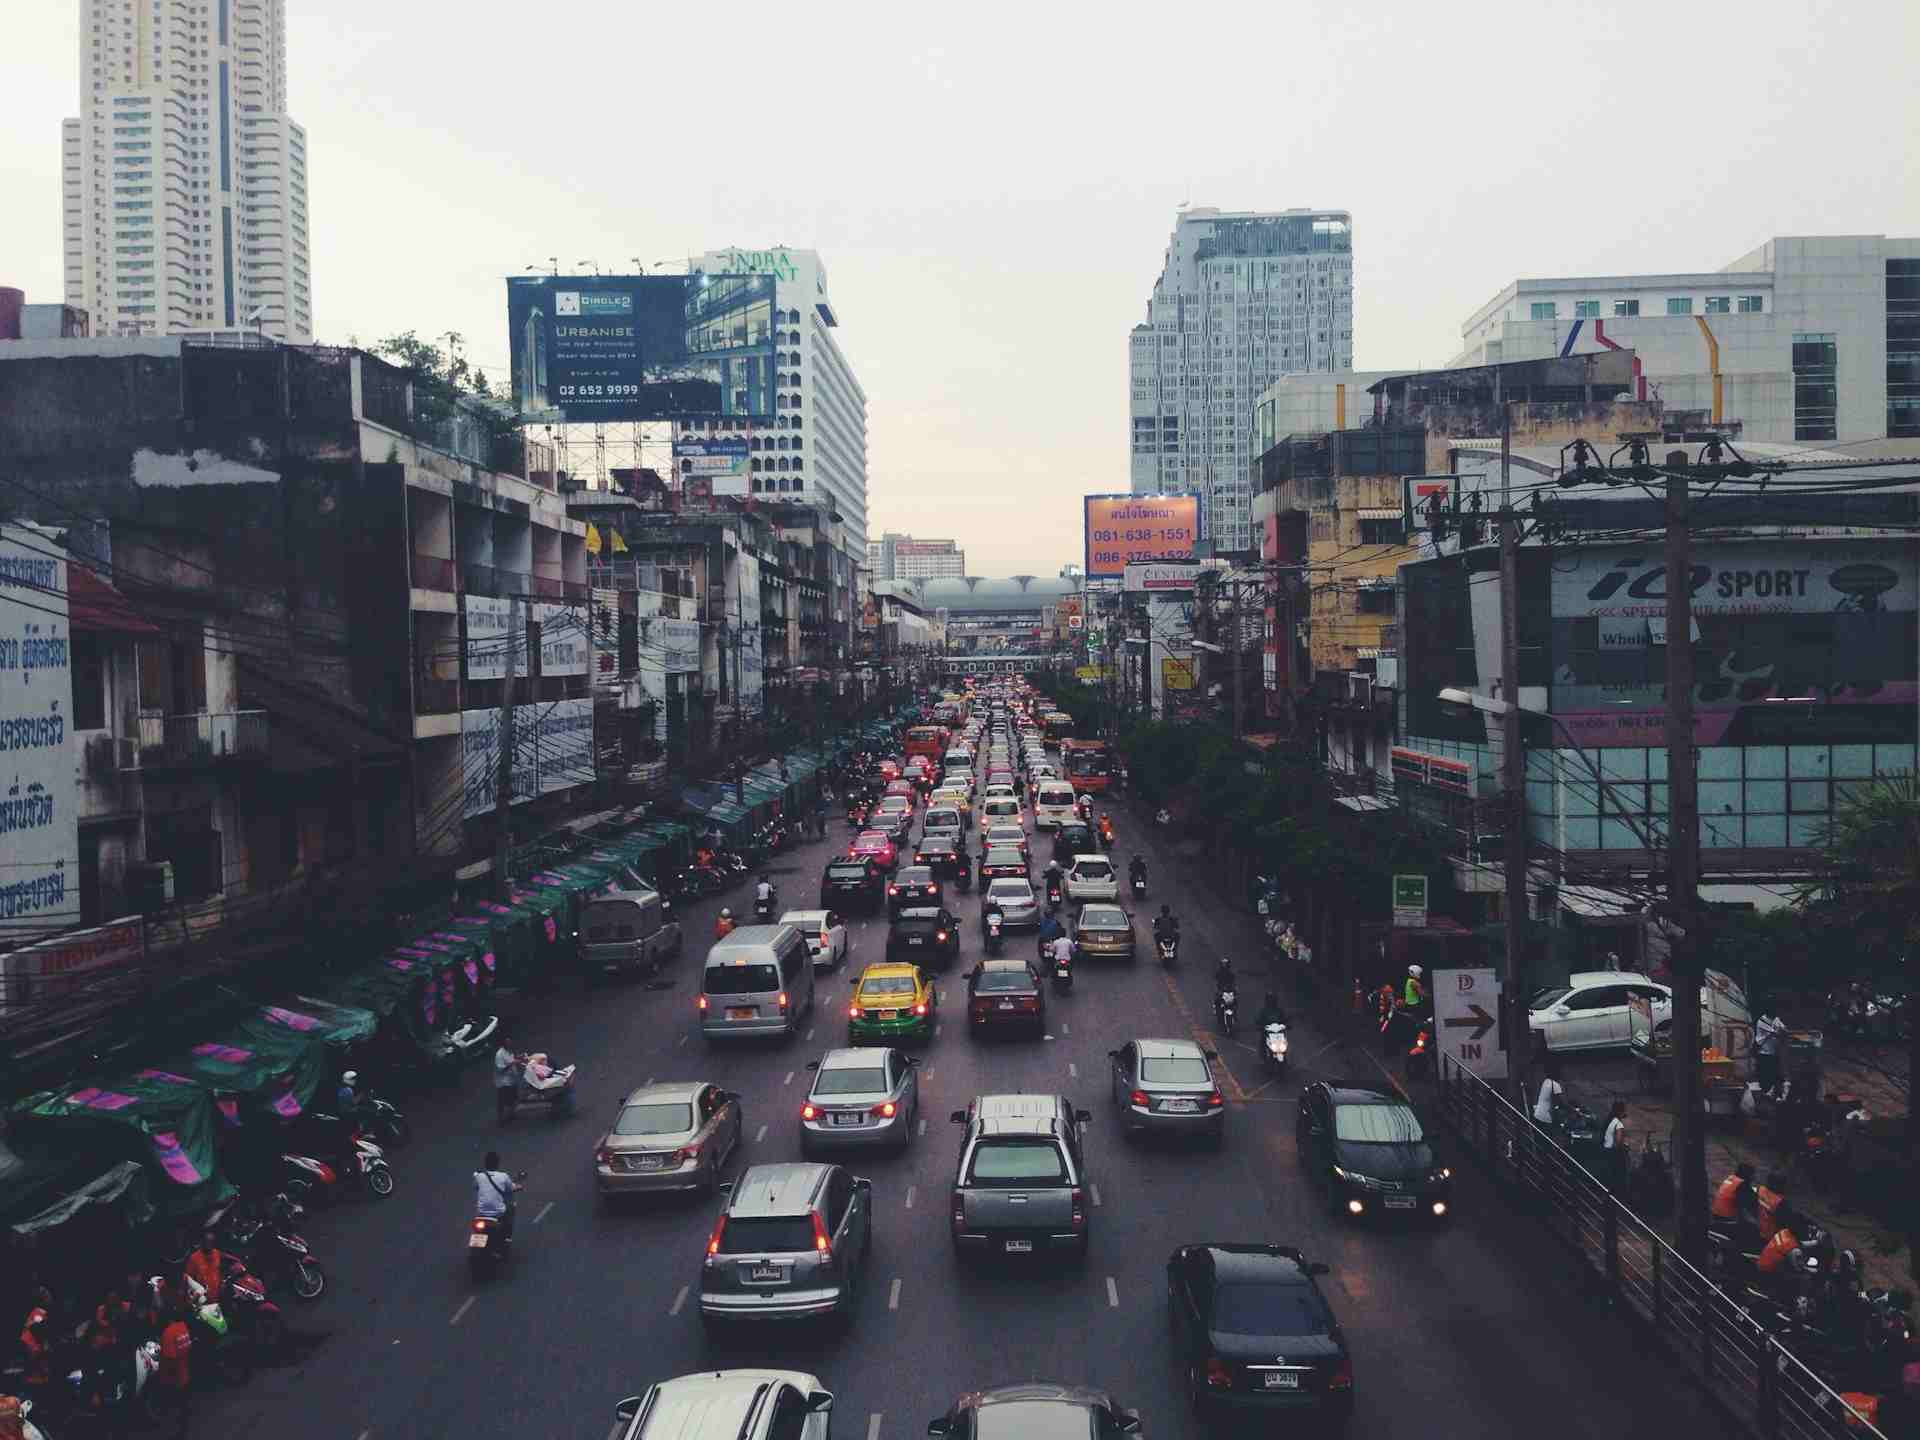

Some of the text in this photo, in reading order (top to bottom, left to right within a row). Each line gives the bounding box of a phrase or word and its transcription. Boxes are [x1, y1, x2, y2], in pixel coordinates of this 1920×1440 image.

[556, 326, 635, 337] URBANISE
[559, 384, 639, 396] 02 652 9999
[1094, 528, 1191, 541] 081-638-1551
[1717, 570, 1810, 597] SPORT
[1460, 1043, 1482, 1060] IN
